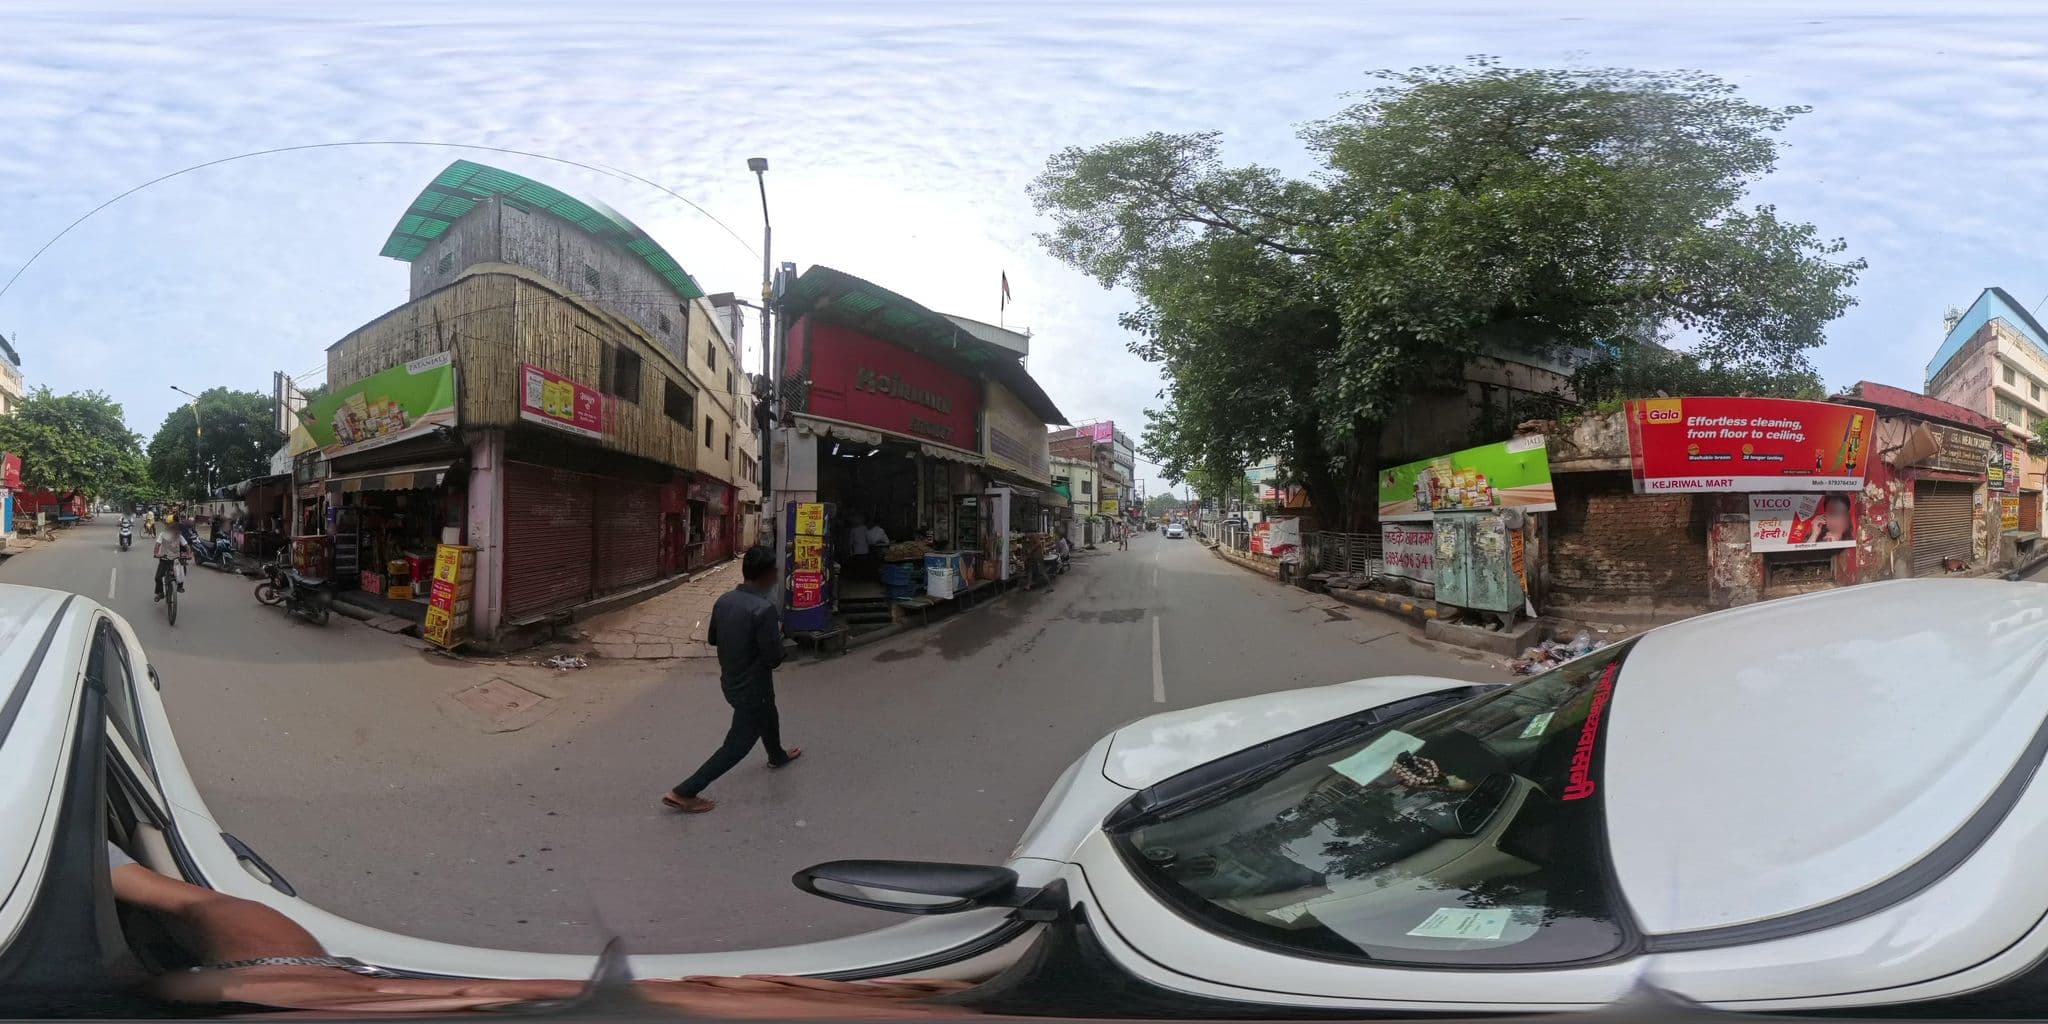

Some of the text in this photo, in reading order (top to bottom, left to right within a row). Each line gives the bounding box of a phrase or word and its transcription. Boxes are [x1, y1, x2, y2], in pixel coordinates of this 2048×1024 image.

[1649, 409, 1679, 420] Gala
[1687, 416, 1802, 430] Effortless cleaning,
[1687, 429, 1806, 443] from floor to ceiling.
[1652, 479, 1734, 489] KEJRIWAL MART
[1752, 498, 1791, 508] VICCO
